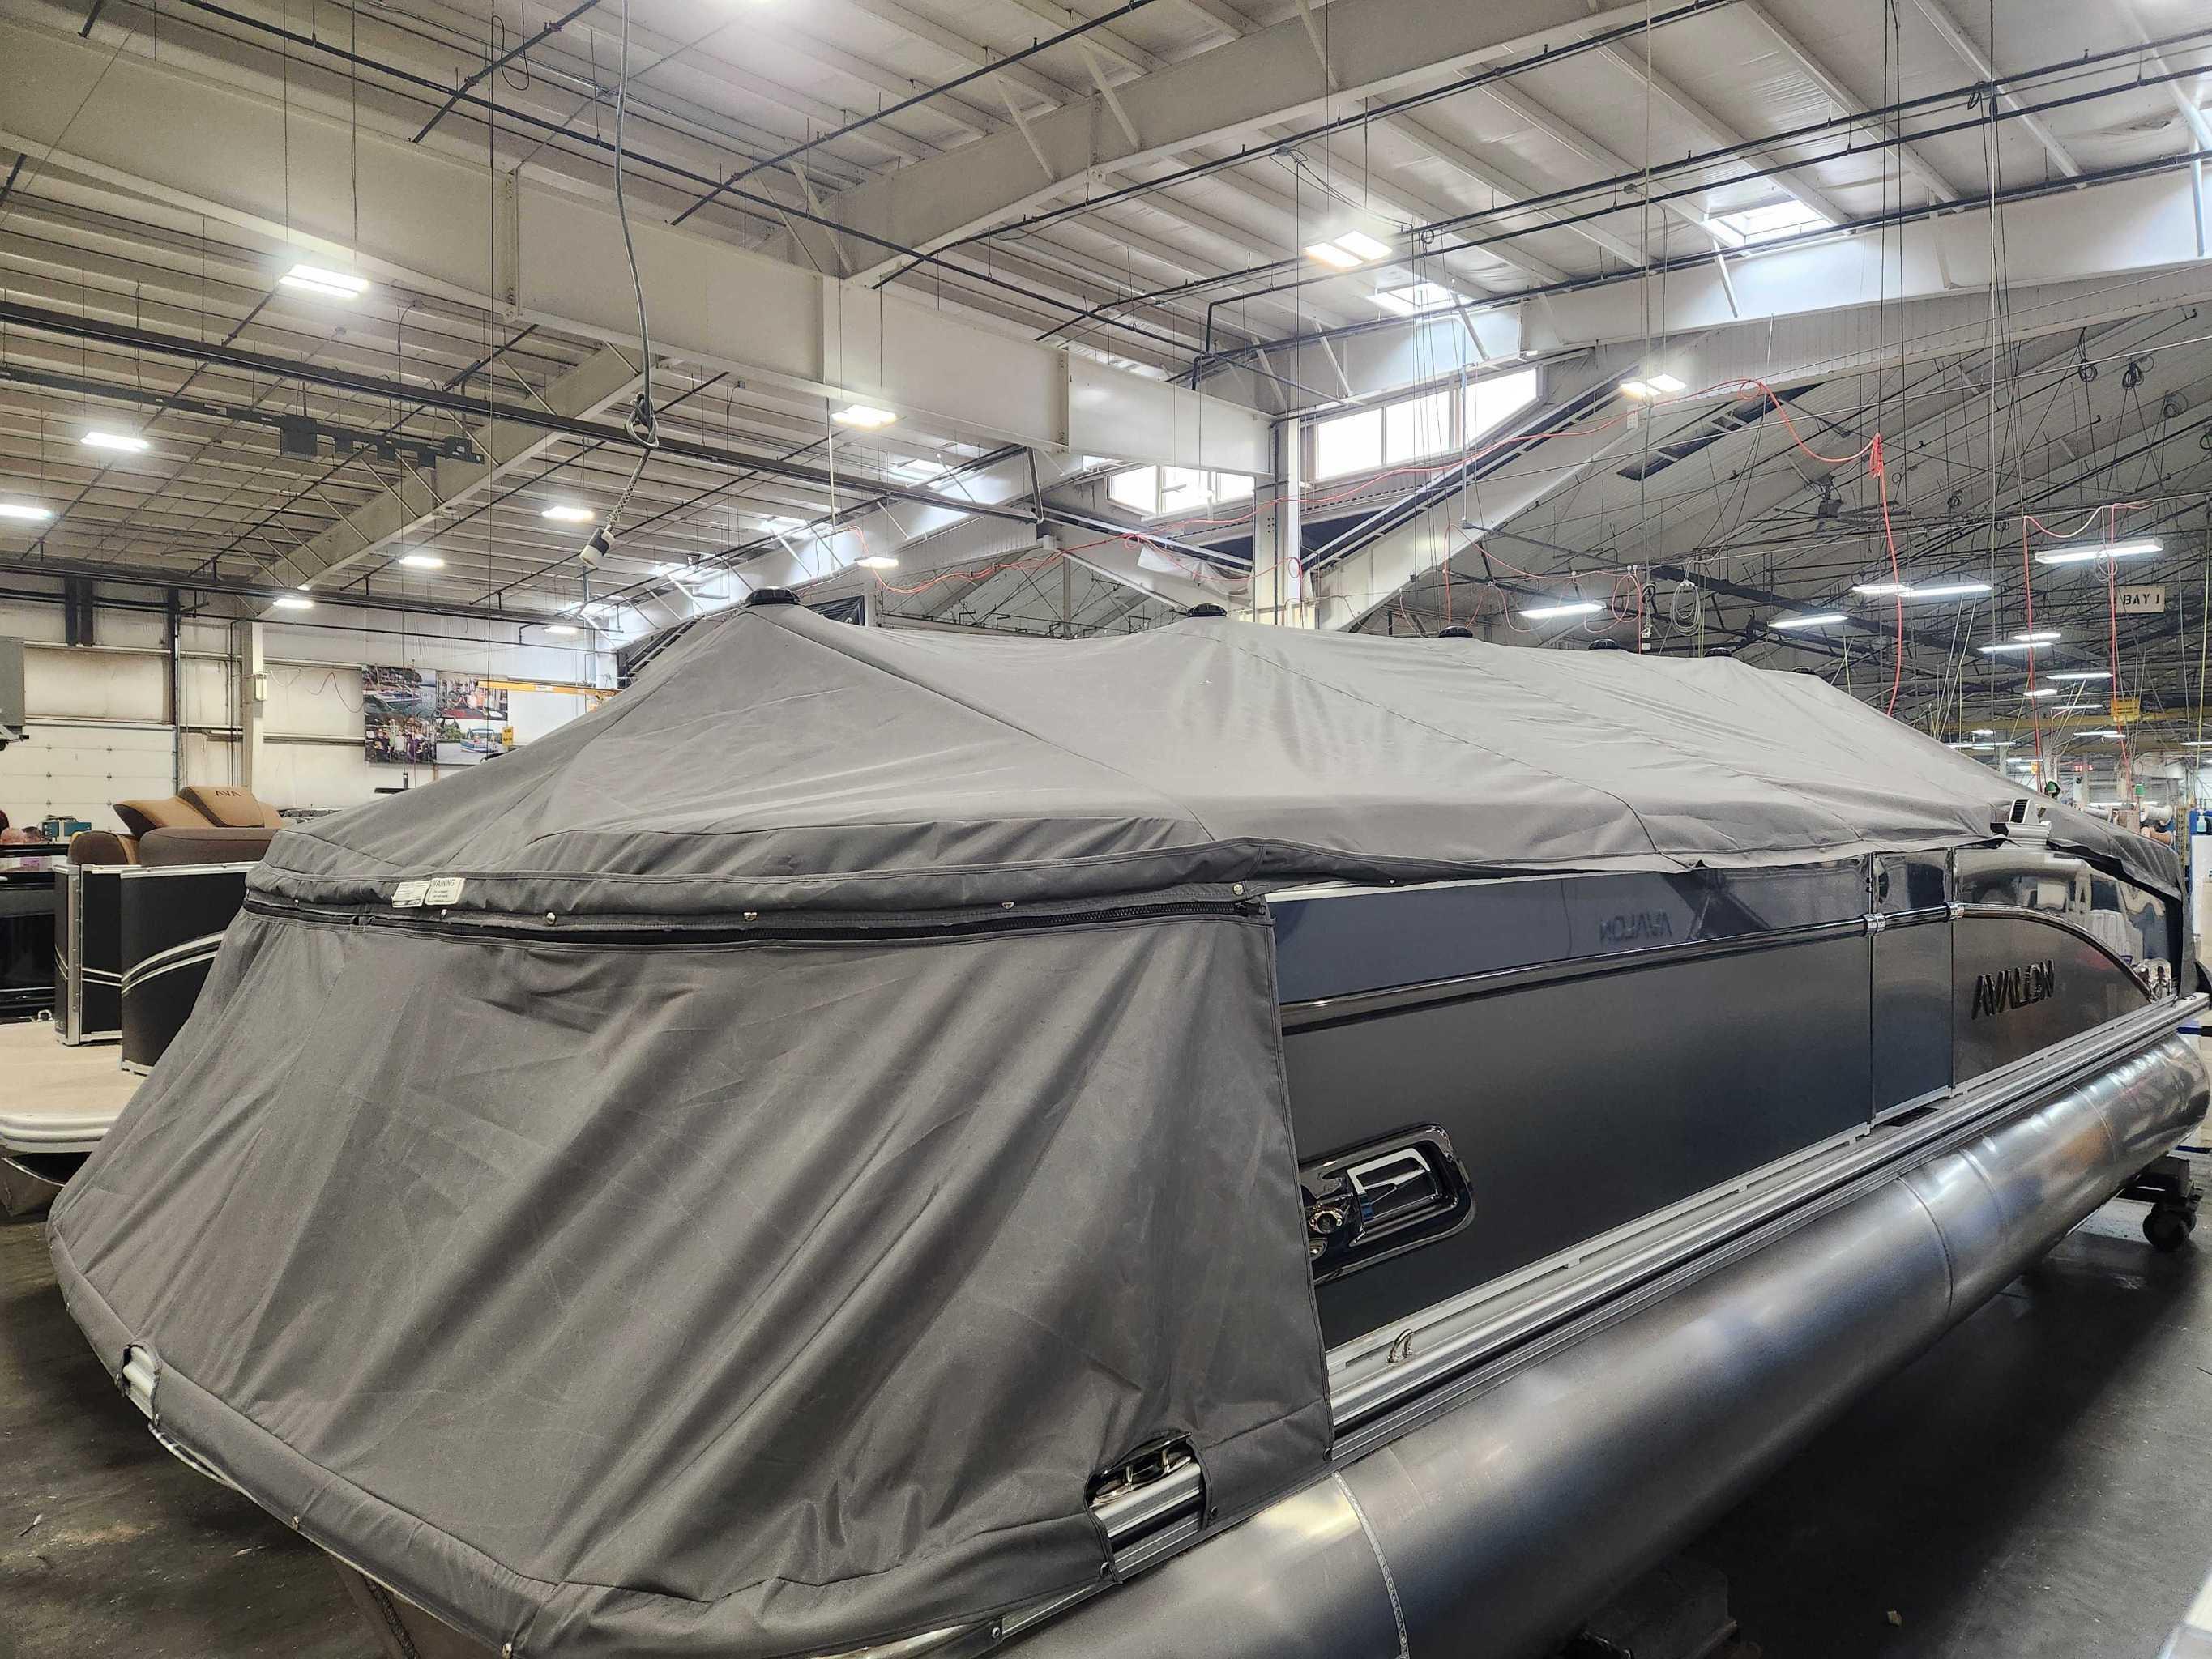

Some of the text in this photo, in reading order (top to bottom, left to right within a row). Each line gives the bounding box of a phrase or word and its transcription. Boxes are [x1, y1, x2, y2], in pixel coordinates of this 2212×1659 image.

[2123, 593, 2160, 605] BAY 1
[1971, 959, 2055, 1021] AVALON
